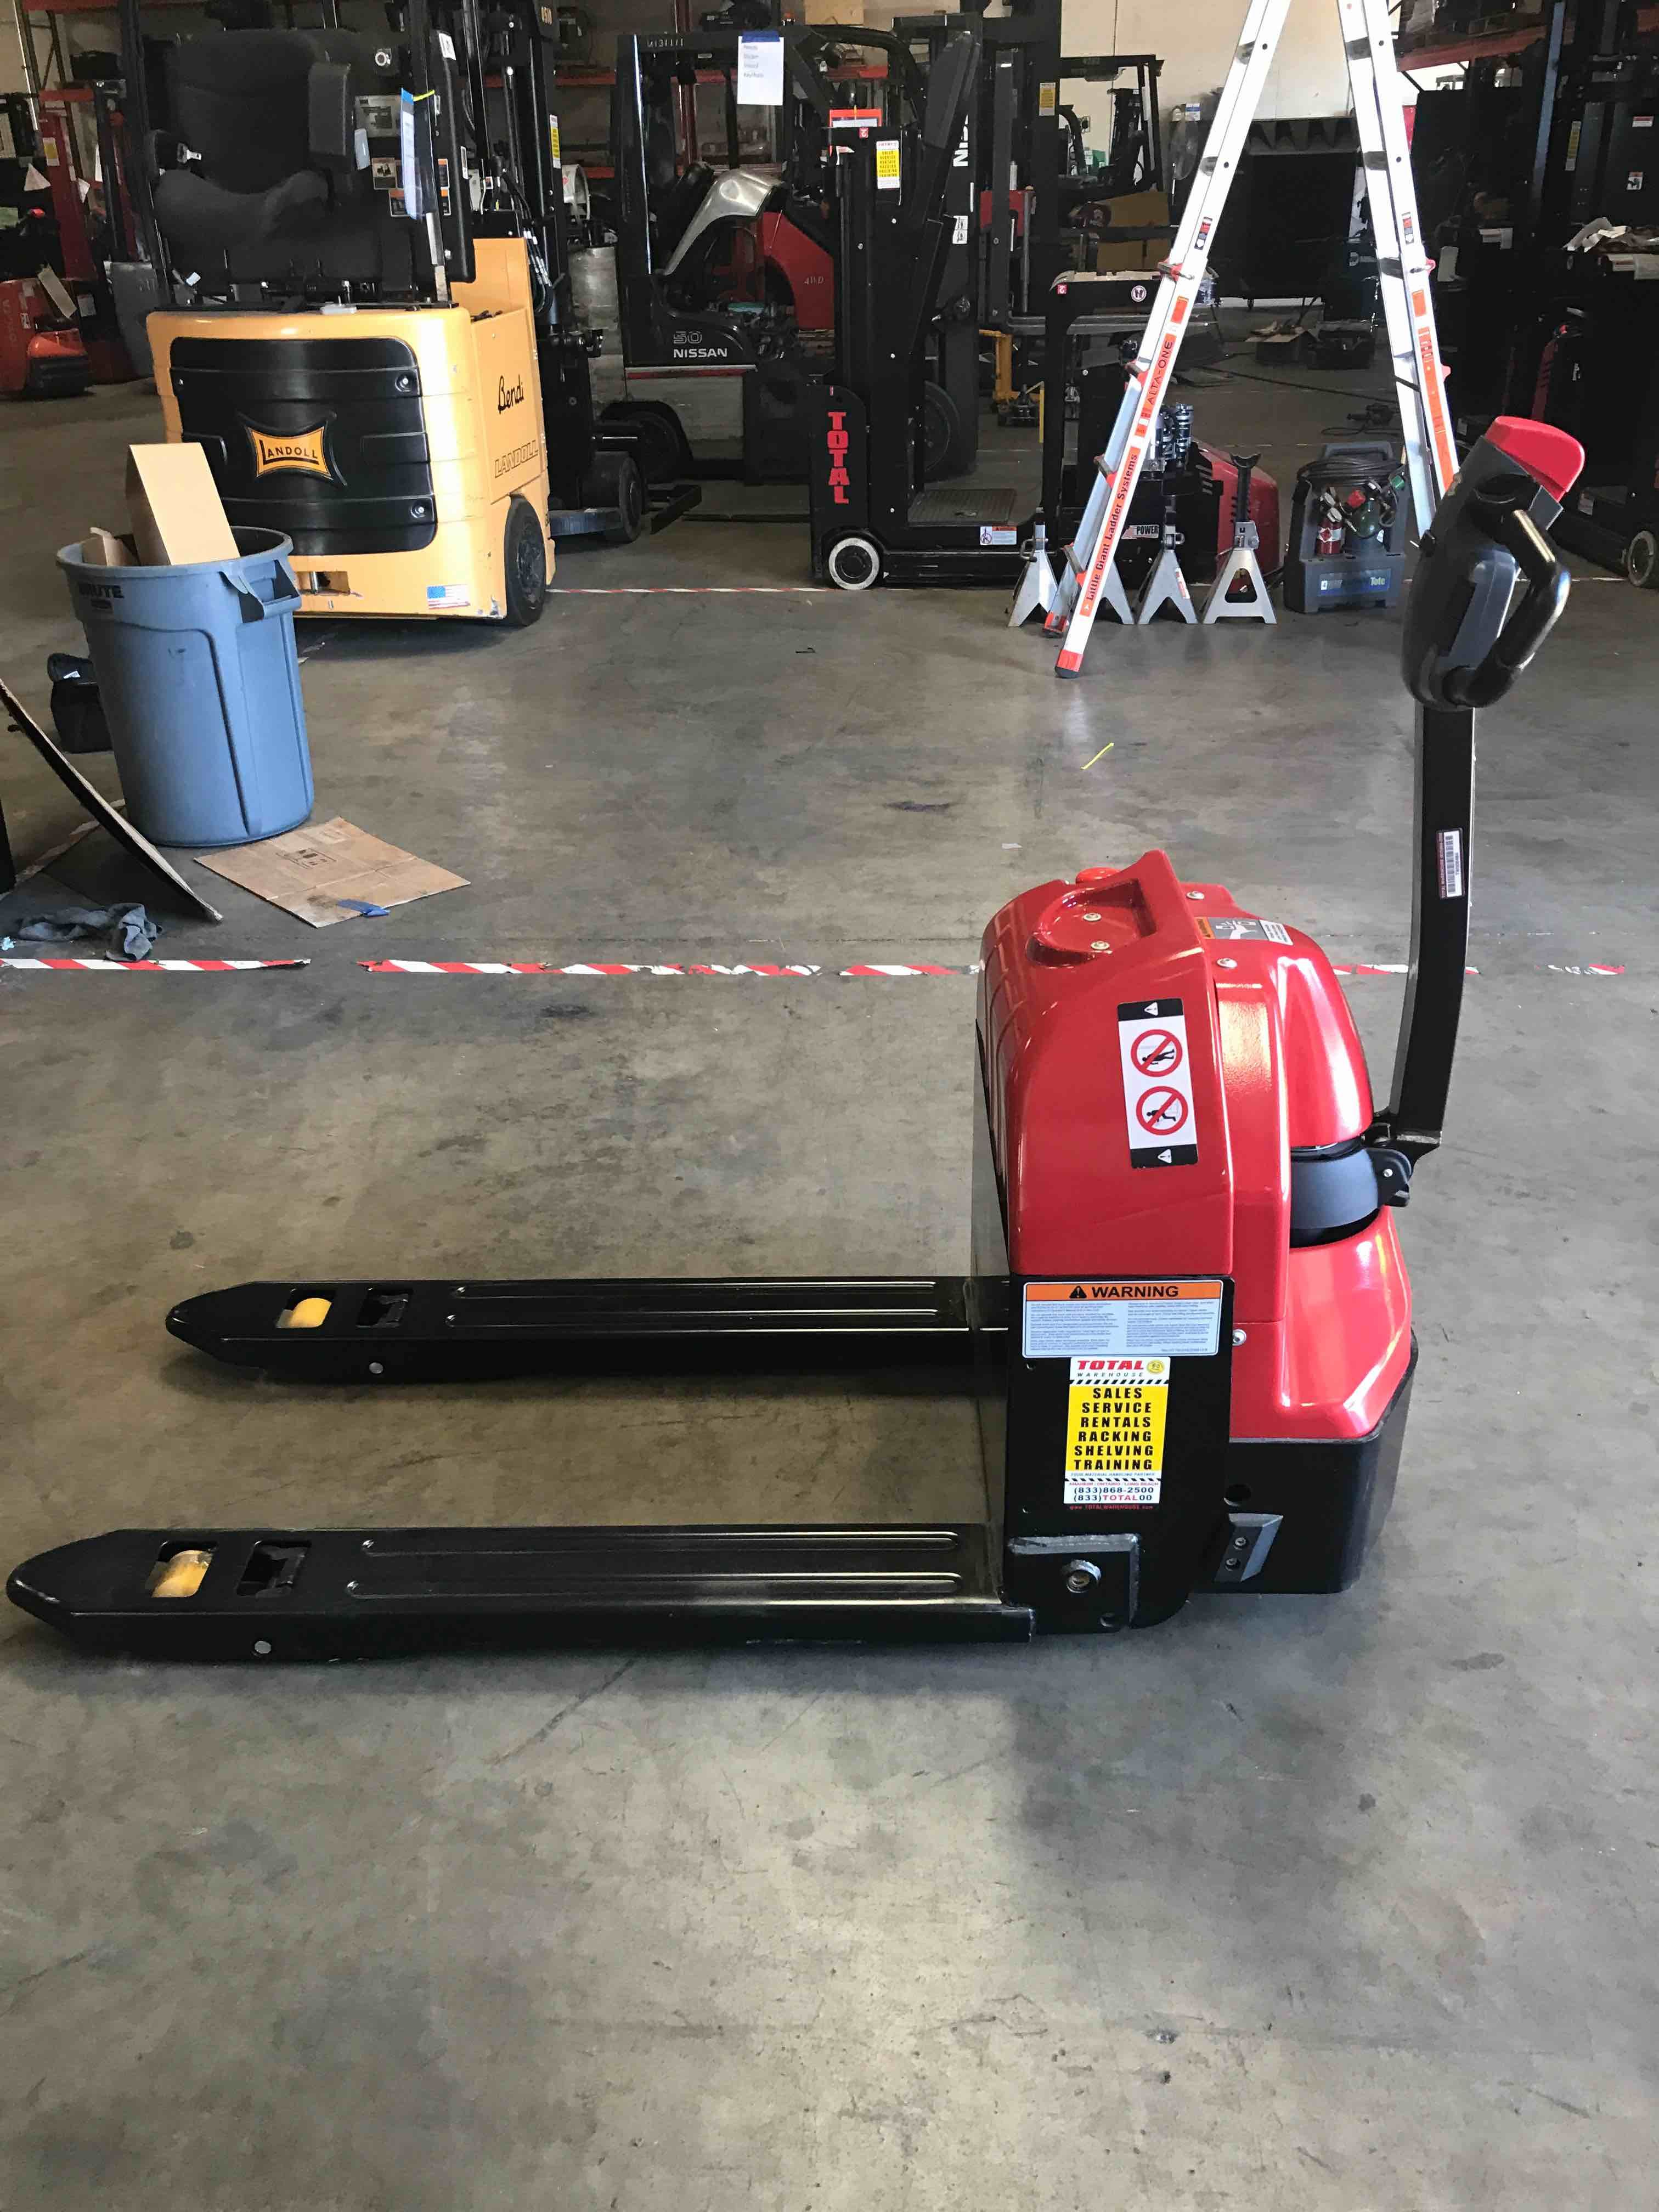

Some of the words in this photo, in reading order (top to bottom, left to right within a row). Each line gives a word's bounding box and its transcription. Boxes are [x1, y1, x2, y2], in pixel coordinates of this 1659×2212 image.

[673, 331, 702, 344] 50
[673, 348, 727, 358] NISSAN
[1147, 341, 1173, 405] ALTA-ONE
[498, 374, 524, 415] Bendi
[259, 439, 319, 465] LANDOLL
[827, 412, 850, 504] TOTAL
[495, 439, 538, 478] LANDOLL
[1088, 574, 1101, 601] Little
[1096, 543, 1110, 570] Giant
[1105, 504, 1122, 540] Ladder
[1117, 453, 1138, 500] Systems
[1092, 1285, 1179, 1298] WARNING
[1077, 1360, 1144, 1370] TOTAL
[1093, 1387, 1142, 1399] SALES
[1082, 1402, 1152, 1413] SERVICE
[1081, 1417, 1151, 1427] RENTALS
[1079, 1431, 1152, 1442] RACKING
[1074, 1446, 1153, 1455] SHELVING
[1074, 1459, 1153, 1470] TRAINING
